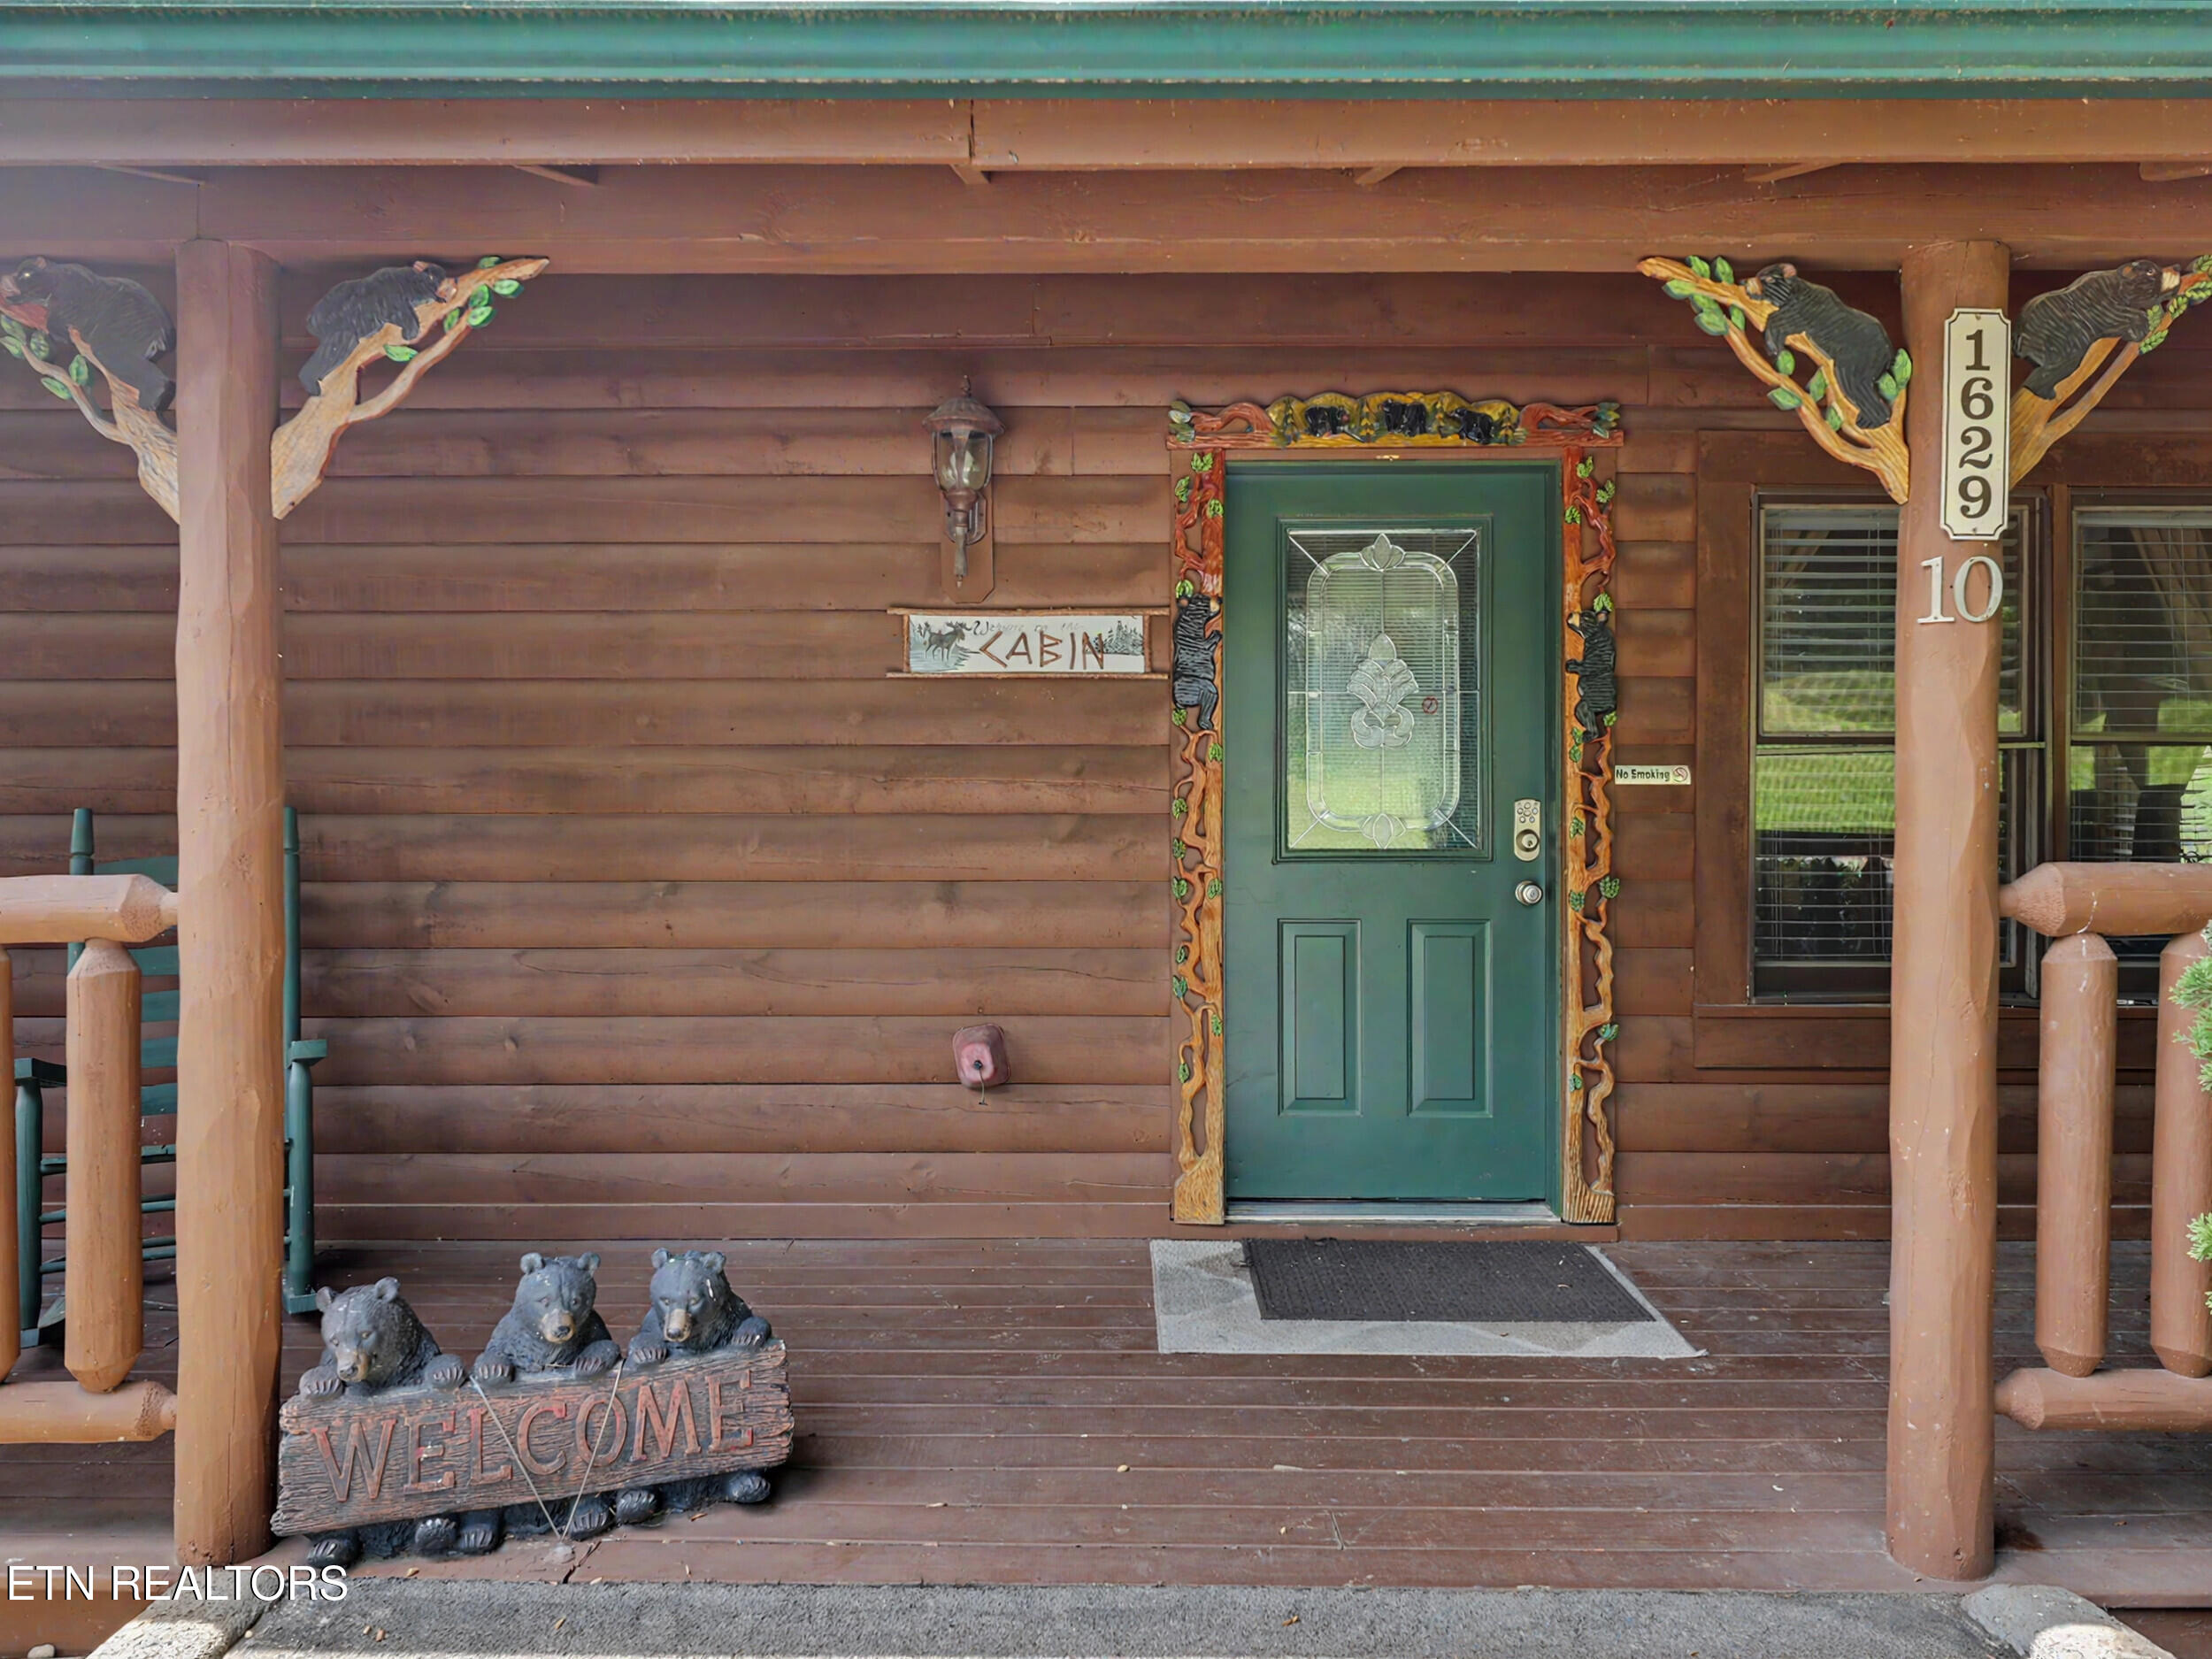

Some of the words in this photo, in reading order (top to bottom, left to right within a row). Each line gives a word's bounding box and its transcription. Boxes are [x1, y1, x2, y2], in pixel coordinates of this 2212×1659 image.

[1958, 328, 1994, 519] 1629
[1916, 555, 2004, 624] 10
[979, 630, 1104, 671] CABIN
[1616, 768, 1629, 780] No
[1631, 768, 1671, 782] Smoking
[310, 1368, 756, 1502] WELCOME
